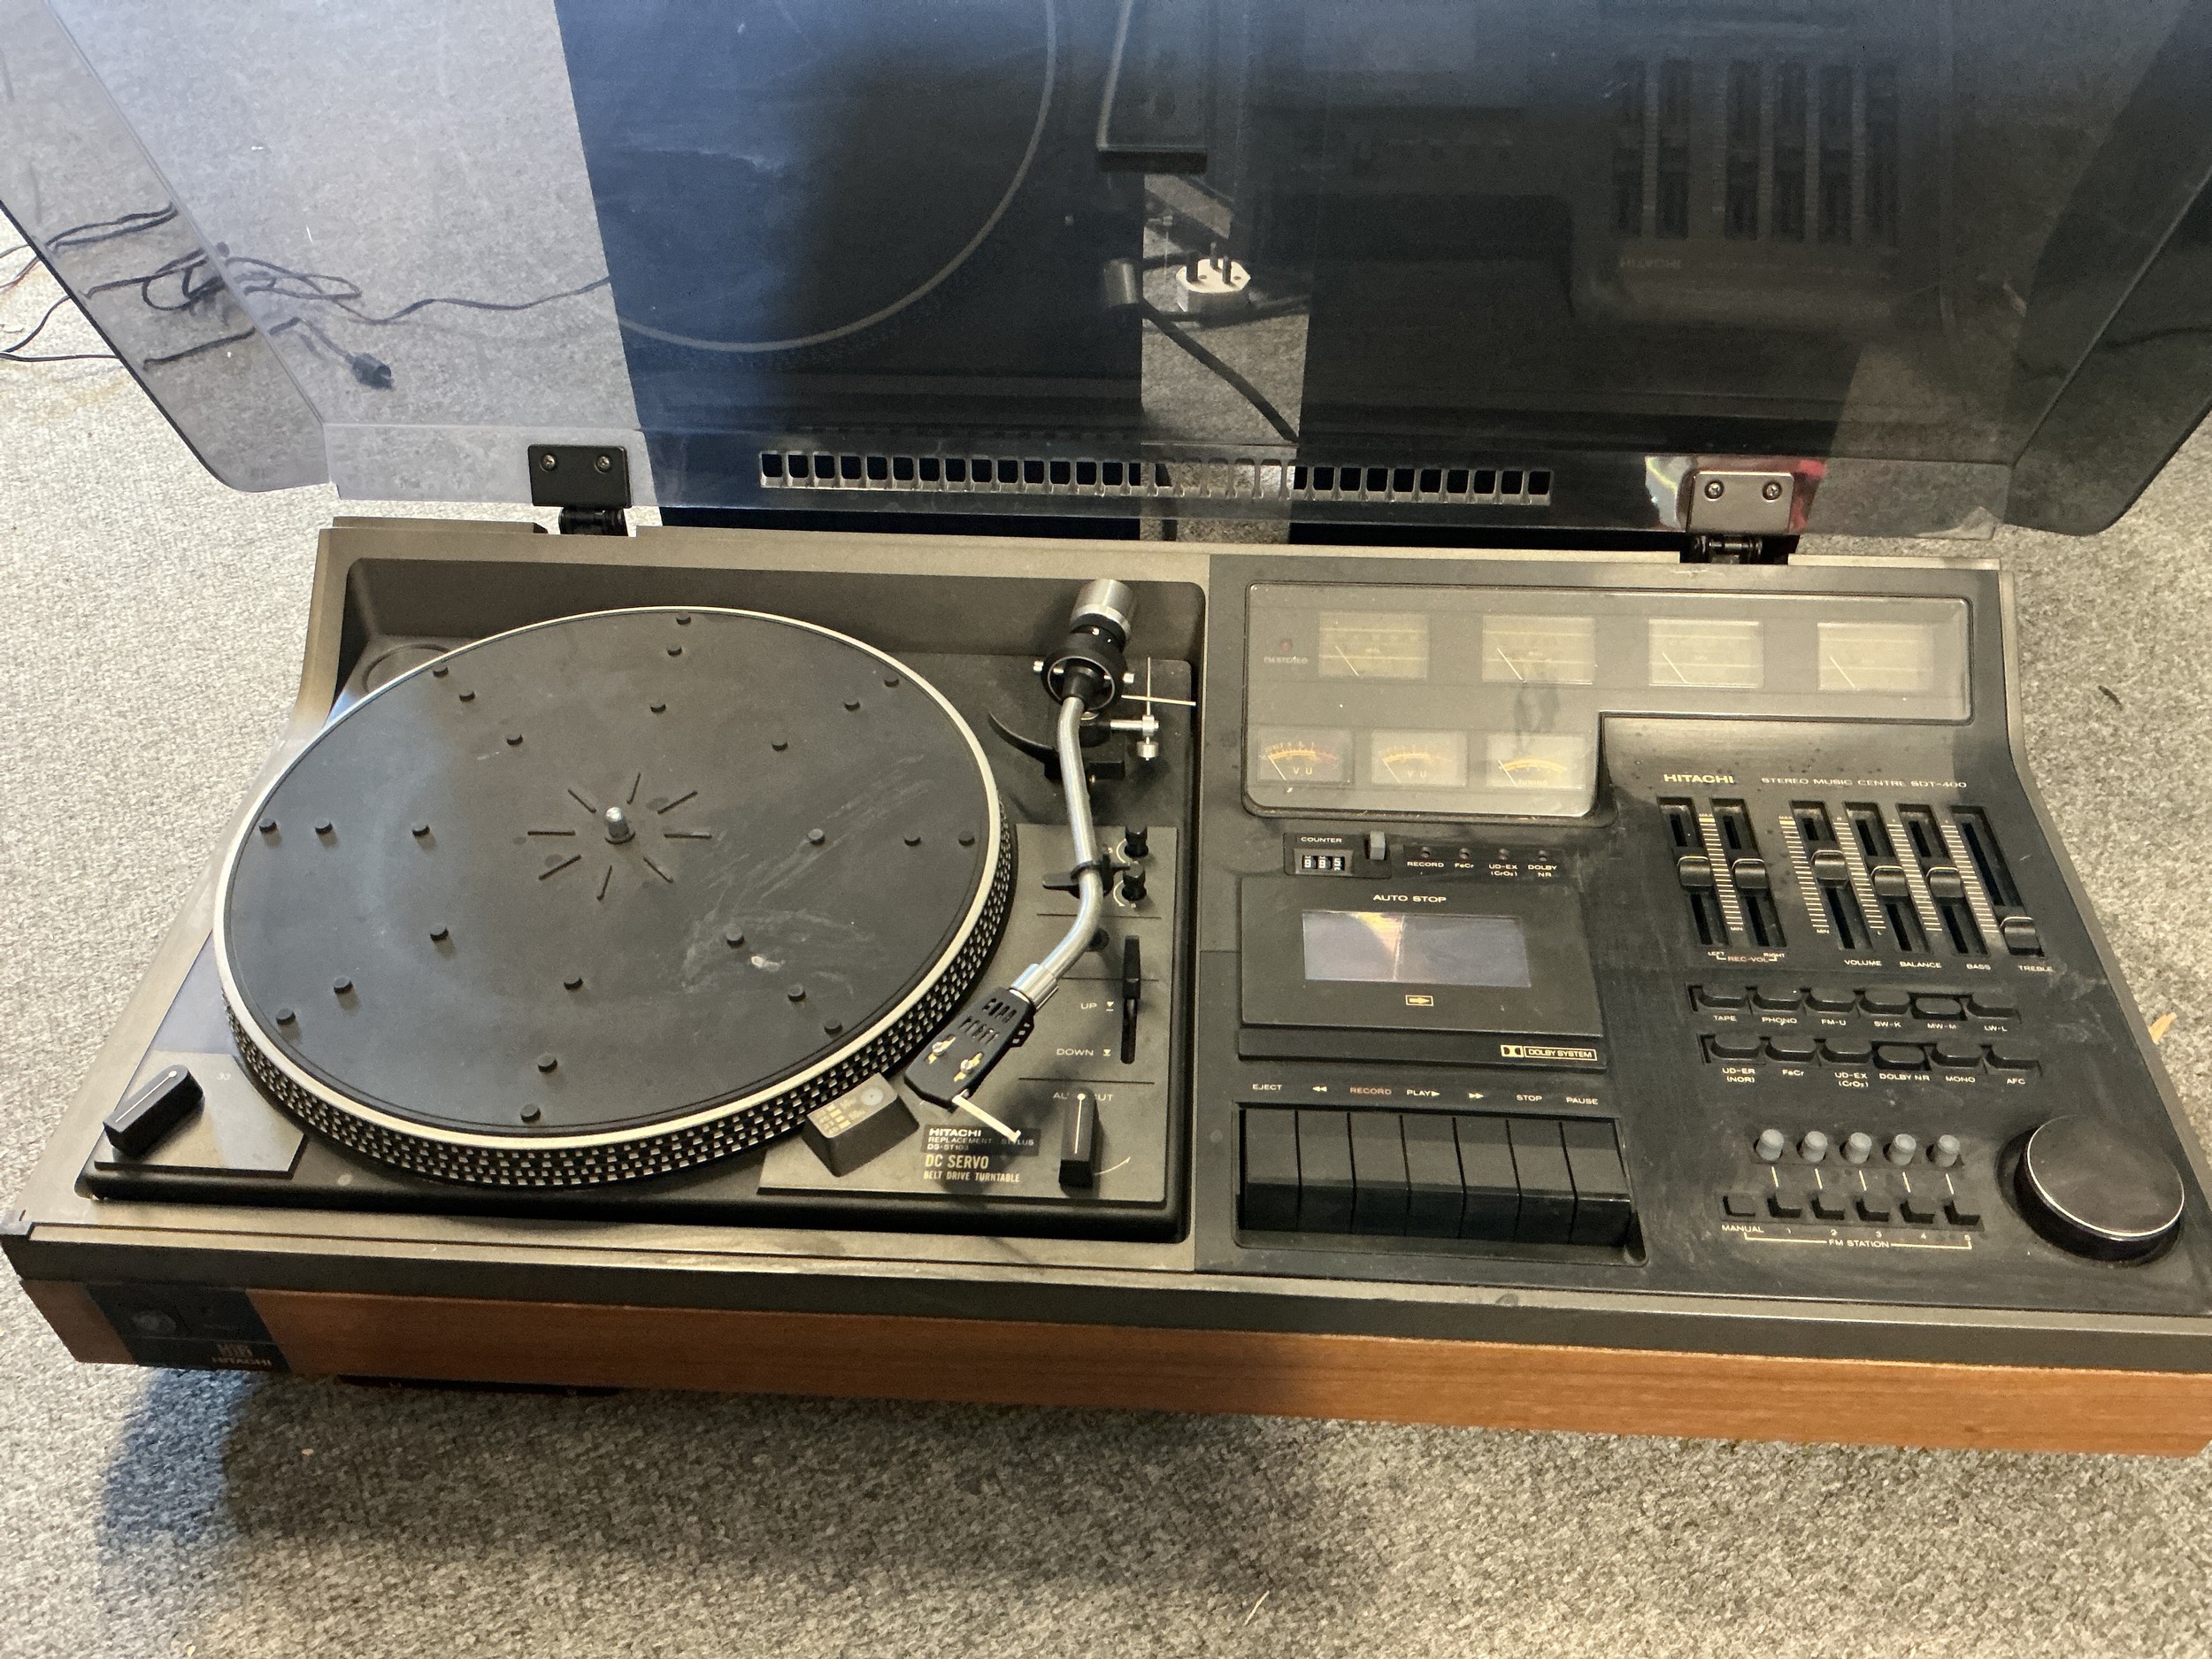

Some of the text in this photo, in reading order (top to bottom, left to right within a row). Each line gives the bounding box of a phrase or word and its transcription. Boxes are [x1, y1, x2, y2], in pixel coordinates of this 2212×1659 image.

[1663, 773, 1734, 784] HITACHI
[1056, 1048, 1094, 1056] DOWN
[1350, 1087, 1392, 1095] RECORD
[1517, 1094, 1542, 1102] STOP
[1566, 1096, 1598, 1105] PAUSE
[929, 1128, 981, 1137] HITACHI
[925, 1154, 989, 1169] DC SERVO
[923, 1170, 1020, 1183] BELT DRIVE TURNTABLE
[1721, 1225, 1764, 1233] MANUAL
[1847, 1240, 1890, 1248] STATION
